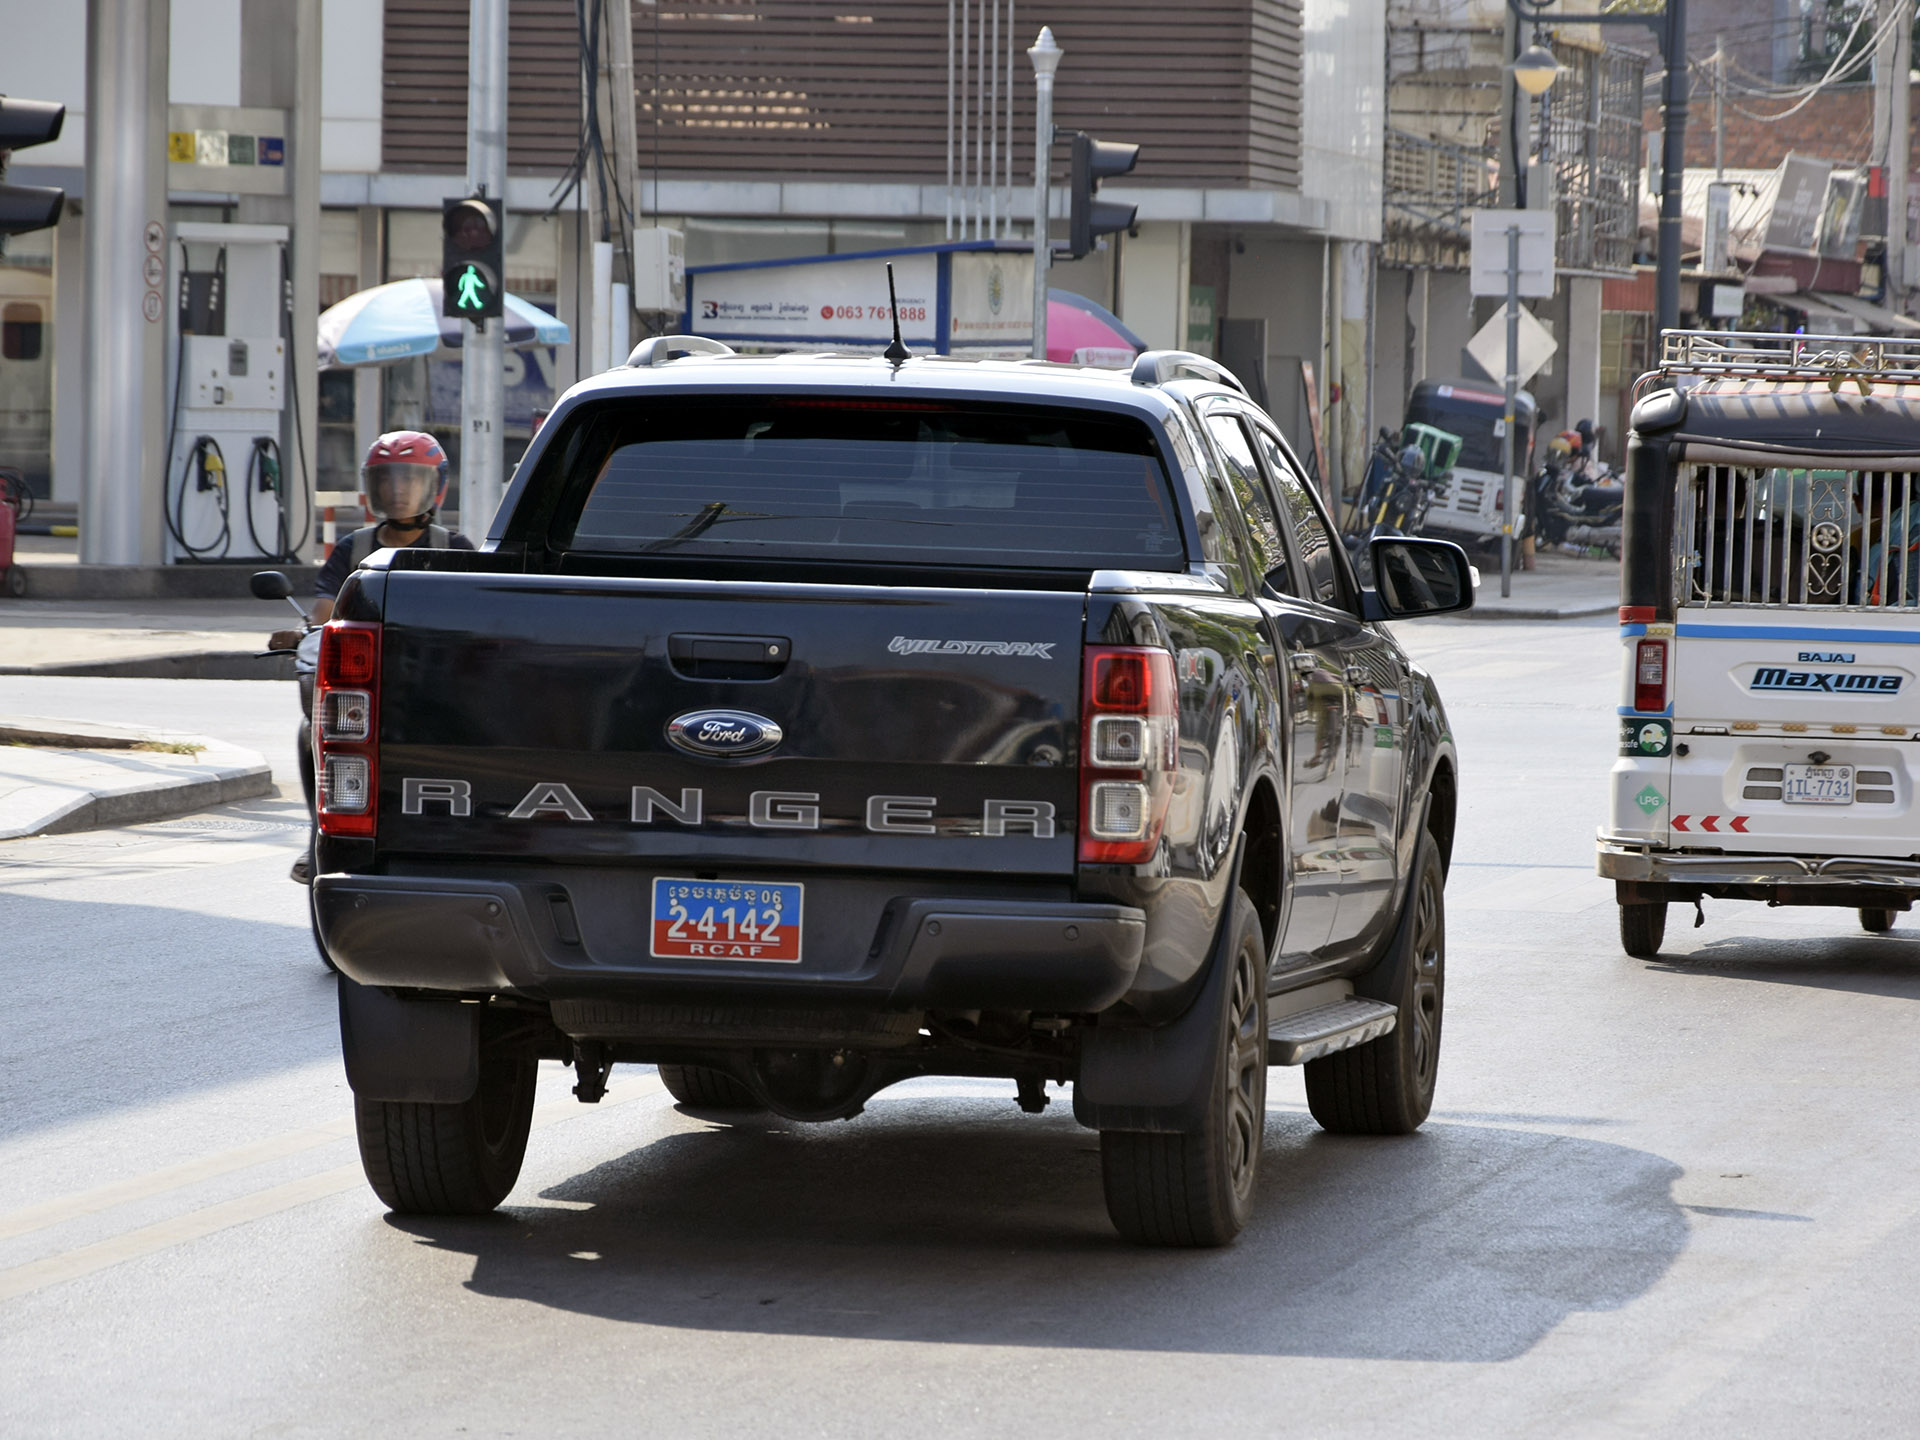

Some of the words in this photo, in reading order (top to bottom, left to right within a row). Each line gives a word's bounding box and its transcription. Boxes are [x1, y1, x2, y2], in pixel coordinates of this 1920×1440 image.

[836, 306, 863, 319] 063
[868, 306, 892, 320] 761
[899, 307, 926, 321] 888
[472, 419, 491, 433] P1
[887, 636, 1056, 659] WILDTRAK
[1797, 652, 1856, 663] BAJAJ
[1751, 667, 1903, 692] Maxima
[698, 720, 746, 742] Ford
[1787, 779, 1850, 796] 1IL-7731
[401, 777, 1056, 838] RANGER
[1639, 795, 1660, 806] LPG
[761, 890, 782, 904] 06
[667, 905, 781, 942] 2-4142
[690, 944, 762, 956] RCAF
